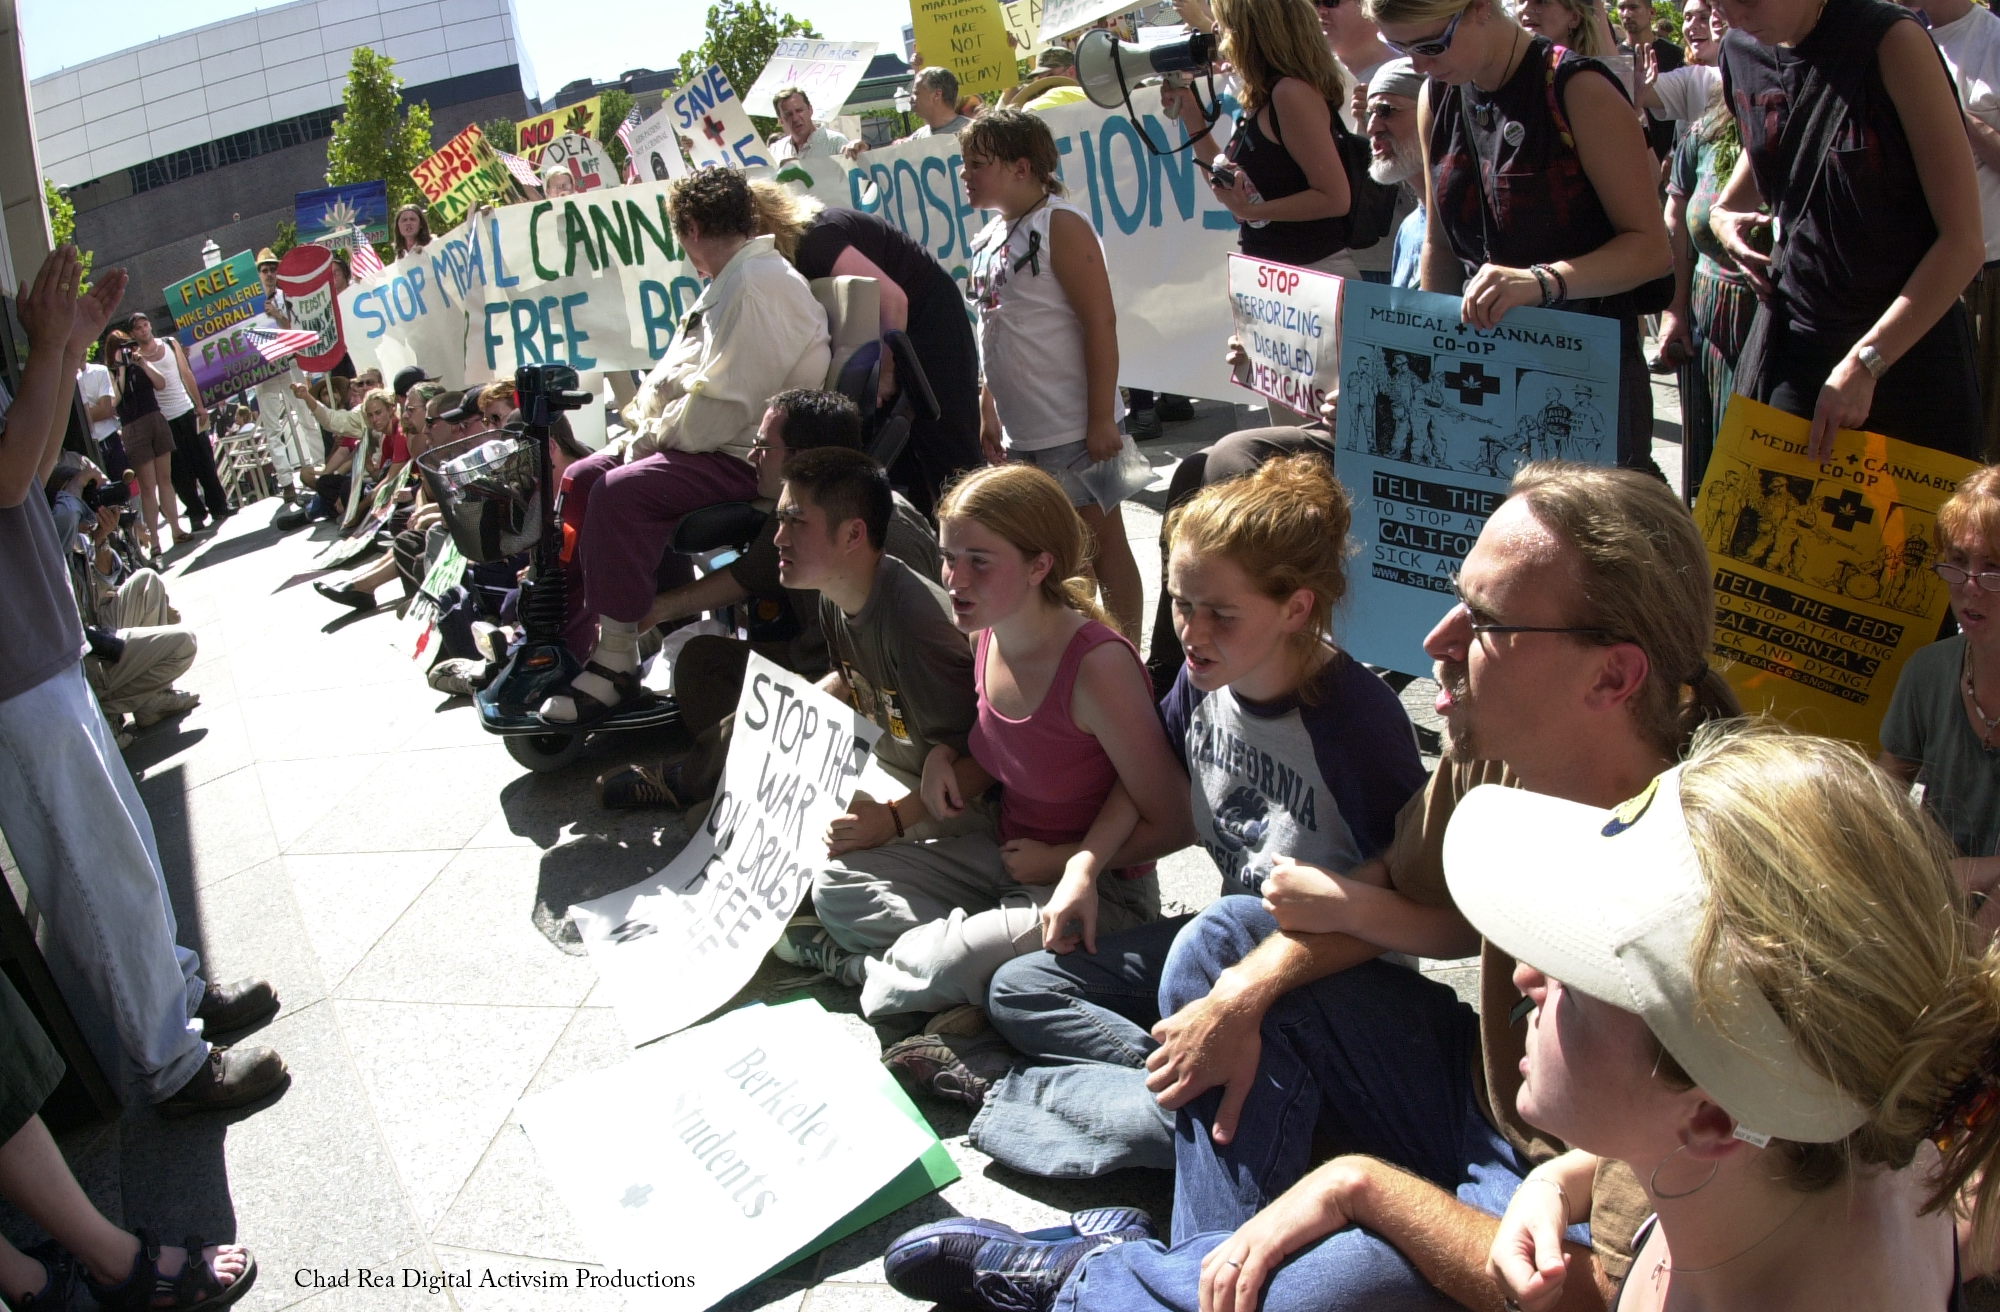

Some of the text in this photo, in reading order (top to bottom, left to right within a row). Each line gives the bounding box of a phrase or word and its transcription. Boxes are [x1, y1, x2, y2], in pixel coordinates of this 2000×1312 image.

[932, 5, 987, 23] PATIENTS
[952, 22, 977, 36] ARE
[776, 42, 809, 58] DEA
[950, 33, 985, 54] NOT
[951, 53, 981, 69] THE
[785, 61, 848, 88] WAR
[957, 61, 1002, 86] NEMY
[674, 64, 735, 130] SAVE
[412, 123, 483, 189] STUDENTS
[520, 118, 555, 153] NO
[547, 136, 592, 164] DEA
[581, 157, 601, 175] OFF
[180, 263, 240, 307] FREE
[352, 266, 428, 339] STOP
[1258, 266, 1300, 296] STOP
[175, 281, 264, 331] MIKE & VALERIE
[193, 302, 255, 342] CORRAL!
[1236, 293, 1323, 338] TERRORIZING
[202, 322, 257, 369] FRE
[484, 292, 598, 371] FREE
[1370, 307, 1584, 352] MEDICAL CANNABIS
[1433, 335, 1496, 356] CO-OP
[223, 351, 261, 379] TODD
[1254, 331, 1315, 377] DISABLED
[1246, 357, 1327, 414] AMERICANS
[1373, 474, 1496, 514] TELL THE
[1819, 463, 1879, 487] CO-OP
[1864, 458, 1957, 493] CANNABIS
[1373, 499, 1395, 516] TO
[1405, 506, 1452, 528] STOP
[1374, 545, 1423, 569] SICK
[1716, 570, 1902, 644] TELL THE FEDS
[1715, 609, 1881, 676] CALIFORNIA'S
[1741, 601, 1787, 623] STOP
[1795, 620, 1895, 661] ATTACKING
[1757, 643, 1793, 663] AND
[1803, 659, 1872, 690] DYING!
[744, 673, 818, 766] STOP
[817, 719, 871, 810] THE
[1193, 720, 1317, 832] CALIFORNIA
[756, 751, 818, 853] WAR
[706, 790, 813, 922] ON DRUGS
[684, 852, 763, 950] FREE
[722, 1045, 854, 1167] Berkeley
[669, 1088, 779, 1219] Students
